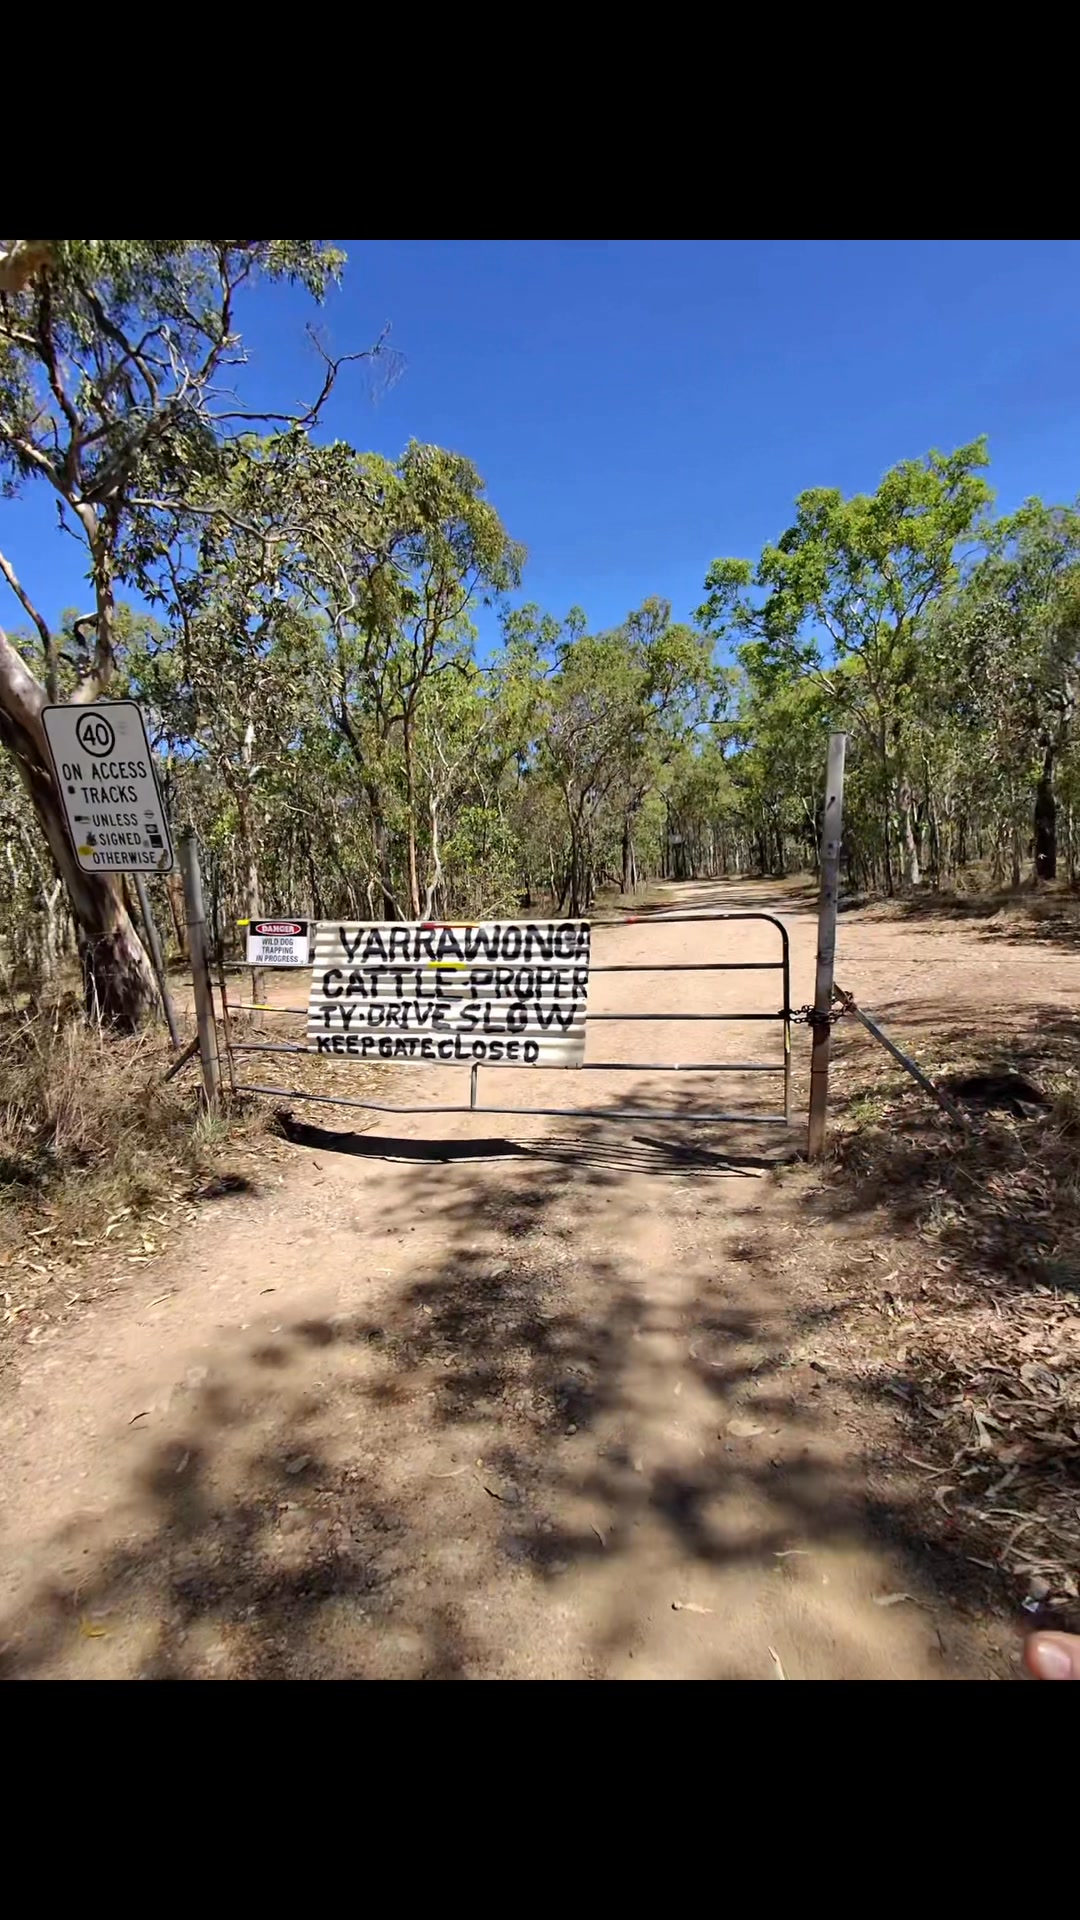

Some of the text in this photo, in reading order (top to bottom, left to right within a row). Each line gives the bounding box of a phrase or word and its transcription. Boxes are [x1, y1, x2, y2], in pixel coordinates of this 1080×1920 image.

[83, 723, 109, 746] 40
[62, 761, 147, 781] ON ACCESS
[81, 786, 138, 804] TRACKS
[92, 814, 138, 827] UNLESS
[98, 833, 141, 846] SIGNED
[92, 851, 156, 864] OTHERWISE
[261, 925, 294, 933] DANGER
[262, 938, 294, 946] WILD DOG
[339, 922, 591, 963] YARRAWONGA
[264, 955, 299, 963] PROGRESS
[456, 1002, 578, 1033] SLOW
[316, 1034, 539, 1063] KEEP GATE CLOSED
